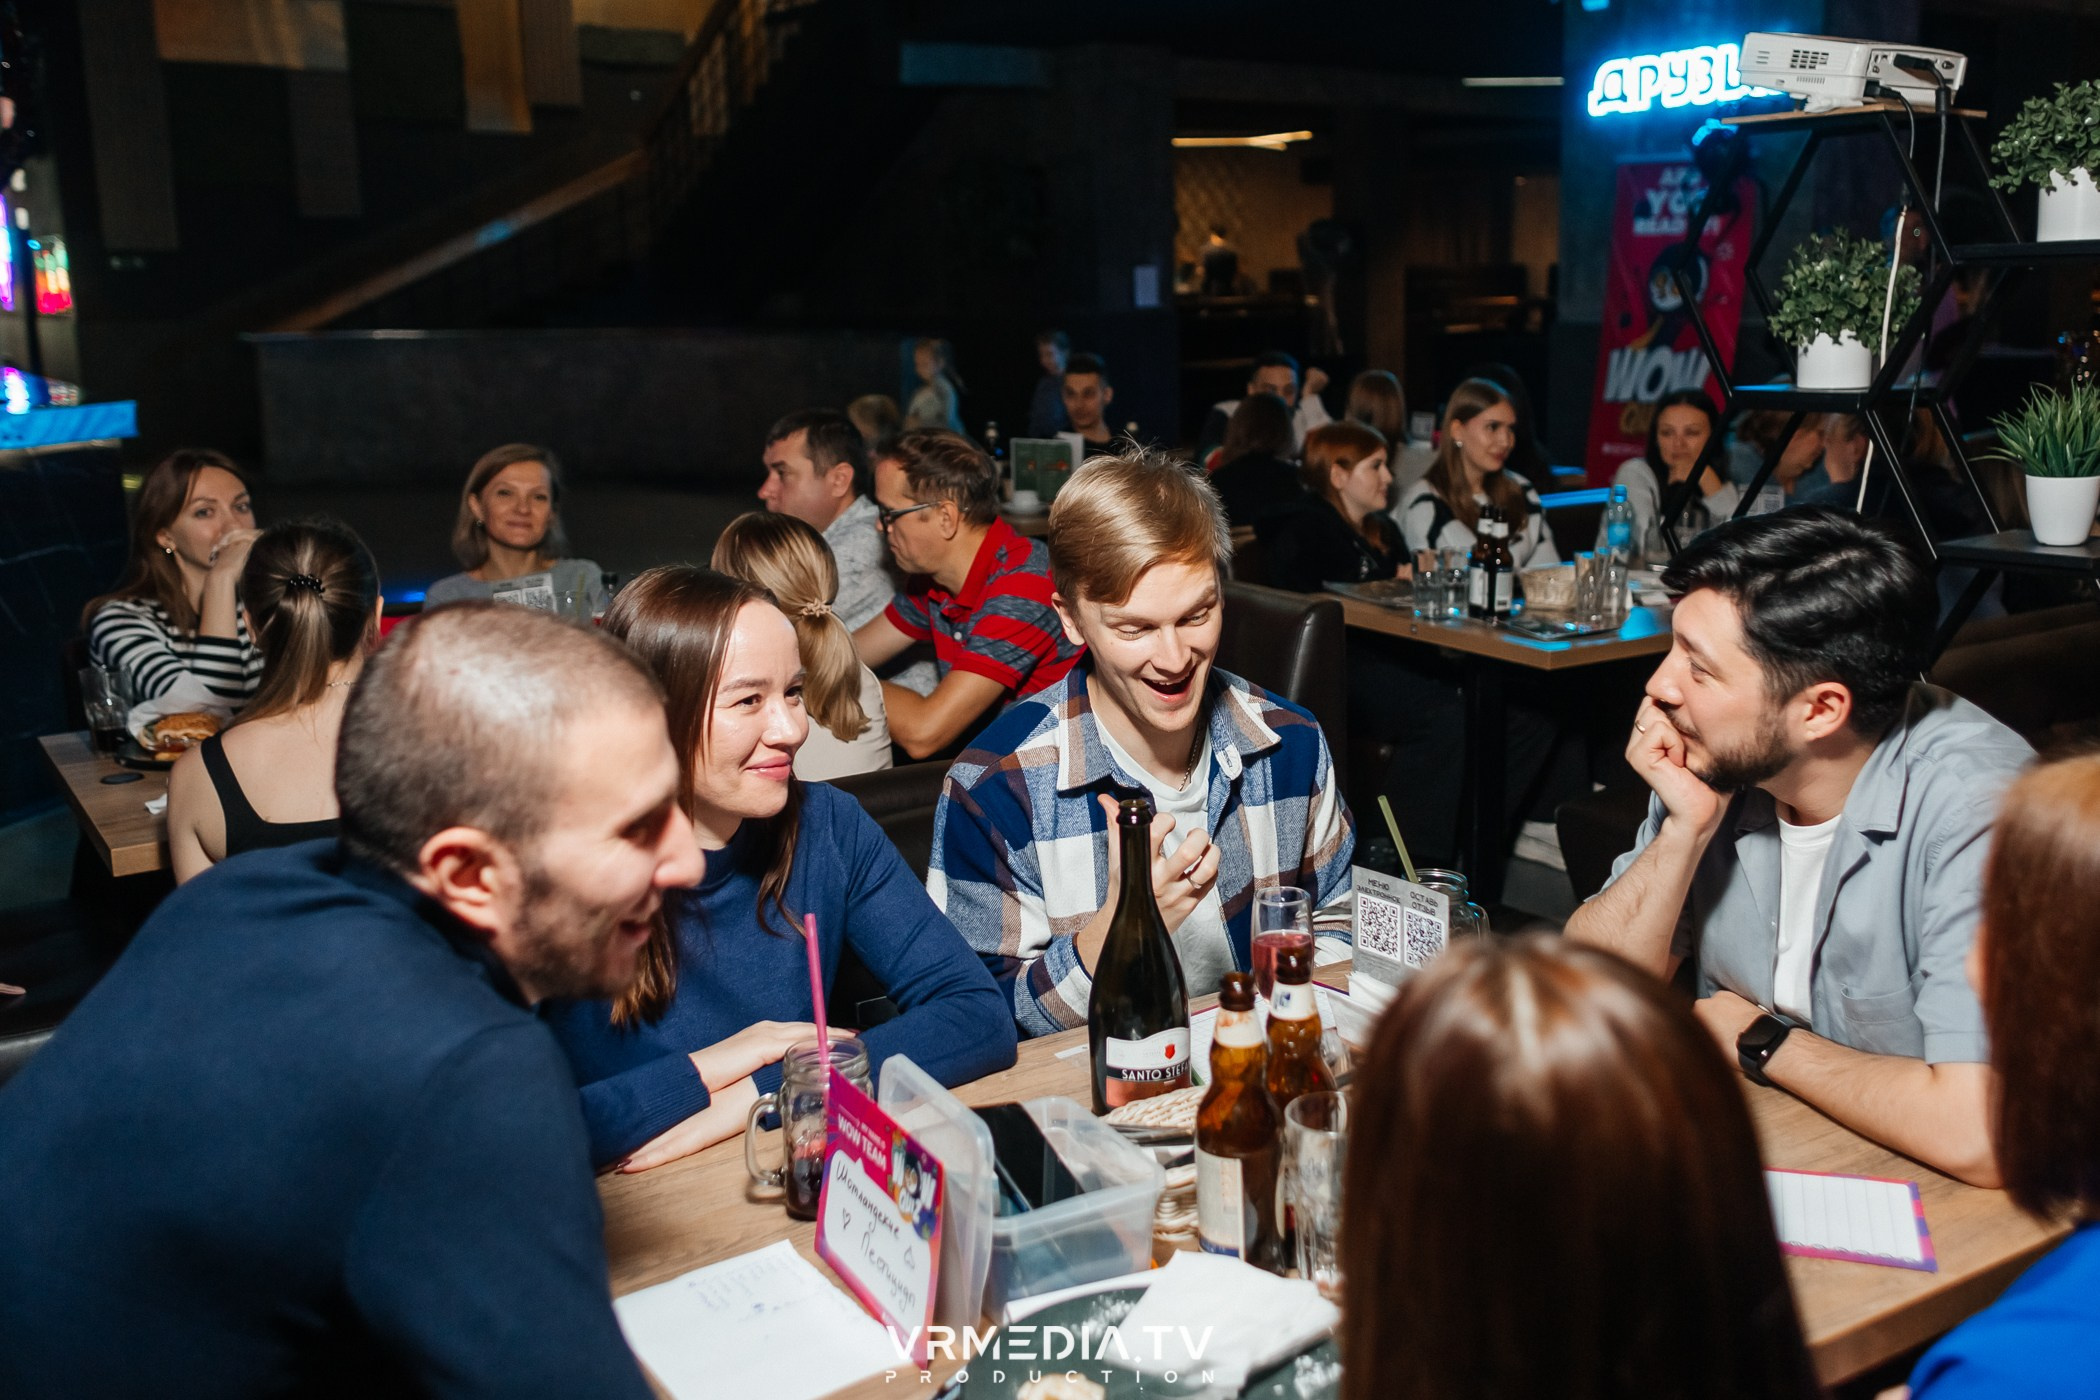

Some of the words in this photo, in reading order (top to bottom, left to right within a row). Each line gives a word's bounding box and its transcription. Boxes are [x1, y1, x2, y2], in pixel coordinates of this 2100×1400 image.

[1588, 43, 1785, 116] ДРУЗЬ
[1604, 345, 1712, 402] WOW
[1368, 878, 1390, 891] МЕНЮ
[1410, 891, 1438, 908] ОСТАВЬ
[1412, 902, 1436, 917] ОТЗЫВ
[1121, 1068, 1161, 1081] SANTO
[838, 1113, 861, 1147] WOW
[862, 1135, 887, 1172] TEAM
